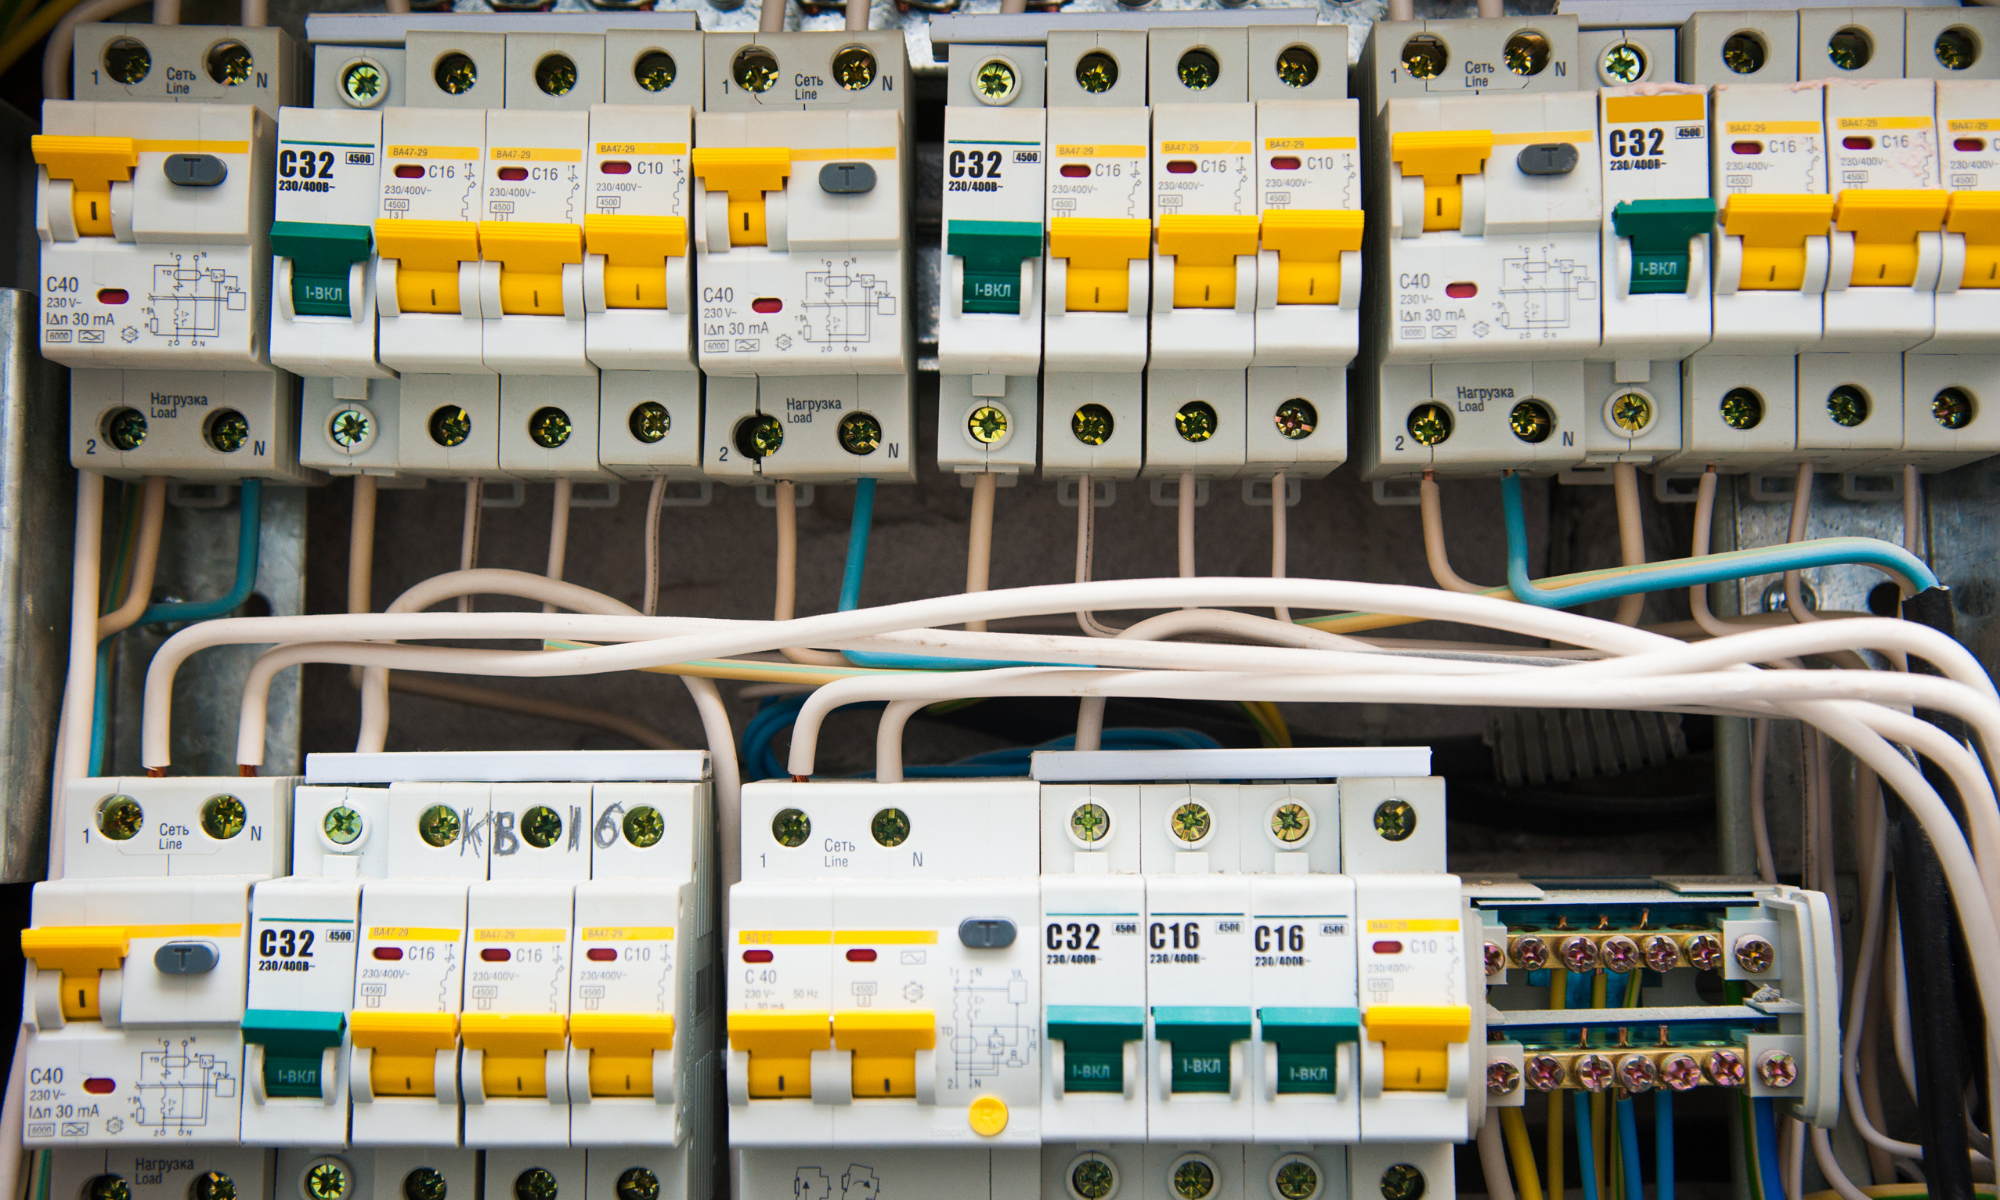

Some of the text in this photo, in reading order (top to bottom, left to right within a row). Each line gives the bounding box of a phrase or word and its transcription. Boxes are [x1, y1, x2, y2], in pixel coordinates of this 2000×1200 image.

[1464, 60, 1495, 73] Сеть
[1554, 61, 1566, 76] N
[91, 70, 98, 85] 1
[166, 67, 196, 82] Сеть
[256, 72, 268, 88] N
[794, 74, 824, 86] Сеть
[1391, 68, 1397, 83] 1
[166, 82, 190, 94] Line
[722, 79, 728, 94] 1
[882, 75, 893, 91] N
[1465, 76, 1489, 88] Line
[794, 88, 818, 100] Line
[1609, 128, 1664, 157] C32
[1769, 140, 1796, 153] C16
[1882, 135, 1910, 148] C16
[279, 150, 334, 178] C32
[348, 154, 370, 164] 4500
[949, 150, 1002, 178] C32
[1016, 152, 1038, 162] 4500
[1307, 156, 1334, 170] C10
[428, 165, 454, 178] C16
[637, 161, 663, 175] C10
[1095, 164, 1120, 176] C16
[1200, 160, 1226, 172] C16
[532, 167, 558, 180] C16
[838, 166, 856, 186] T
[46, 276, 78, 292] C40
[1400, 273, 1430, 289] C40
[703, 287, 734, 303] C40
[1400, 294, 1419, 304] 230
[46, 297, 66, 308] 230
[72, 312, 90, 326] 30
[93, 312, 114, 326] mA
[704, 308, 722, 318] 230
[1426, 309, 1441, 322] 30
[1446, 308, 1466, 321] mA
[728, 322, 744, 335] 30
[749, 322, 770, 334] mA
[150, 392, 208, 408] Нагрузка
[1457, 386, 1514, 401] Нагрузка
[786, 398, 842, 412] Нагрузка
[1458, 400, 1484, 412] Load
[150, 408, 177, 418] Load
[788, 412, 812, 423] Load
[1395, 436, 1404, 450] 2
[1563, 431, 1574, 446] N
[86, 439, 96, 454] 2
[254, 440, 265, 456] N
[888, 443, 898, 458] N
[719, 447, 728, 462] 2
[82, 828, 89, 843] 1
[159, 823, 190, 836] Сеть
[250, 826, 262, 841] N
[158, 838, 182, 850] Line
[824, 838, 856, 852] Сеть
[760, 854, 766, 868] 1
[824, 855, 848, 868] Line
[912, 852, 923, 867] N
[260, 928, 315, 958] C32
[328, 932, 350, 941] 4500
[1046, 923, 1100, 950] C32
[1150, 922, 1200, 950] C16
[1254, 924, 1304, 953] C16
[408, 946, 435, 961] C16
[1410, 940, 1438, 954] C10
[174, 948, 192, 970] T
[516, 948, 542, 962] C16
[624, 948, 650, 962] C10
[30, 1068, 63, 1084] C40
[30, 1090, 50, 1101] 230
[56, 1105, 72, 1118] 30
[78, 1104, 100, 1118] mA
[135, 1158, 194, 1172] Нагрузка
[135, 1172, 162, 1186] Load
